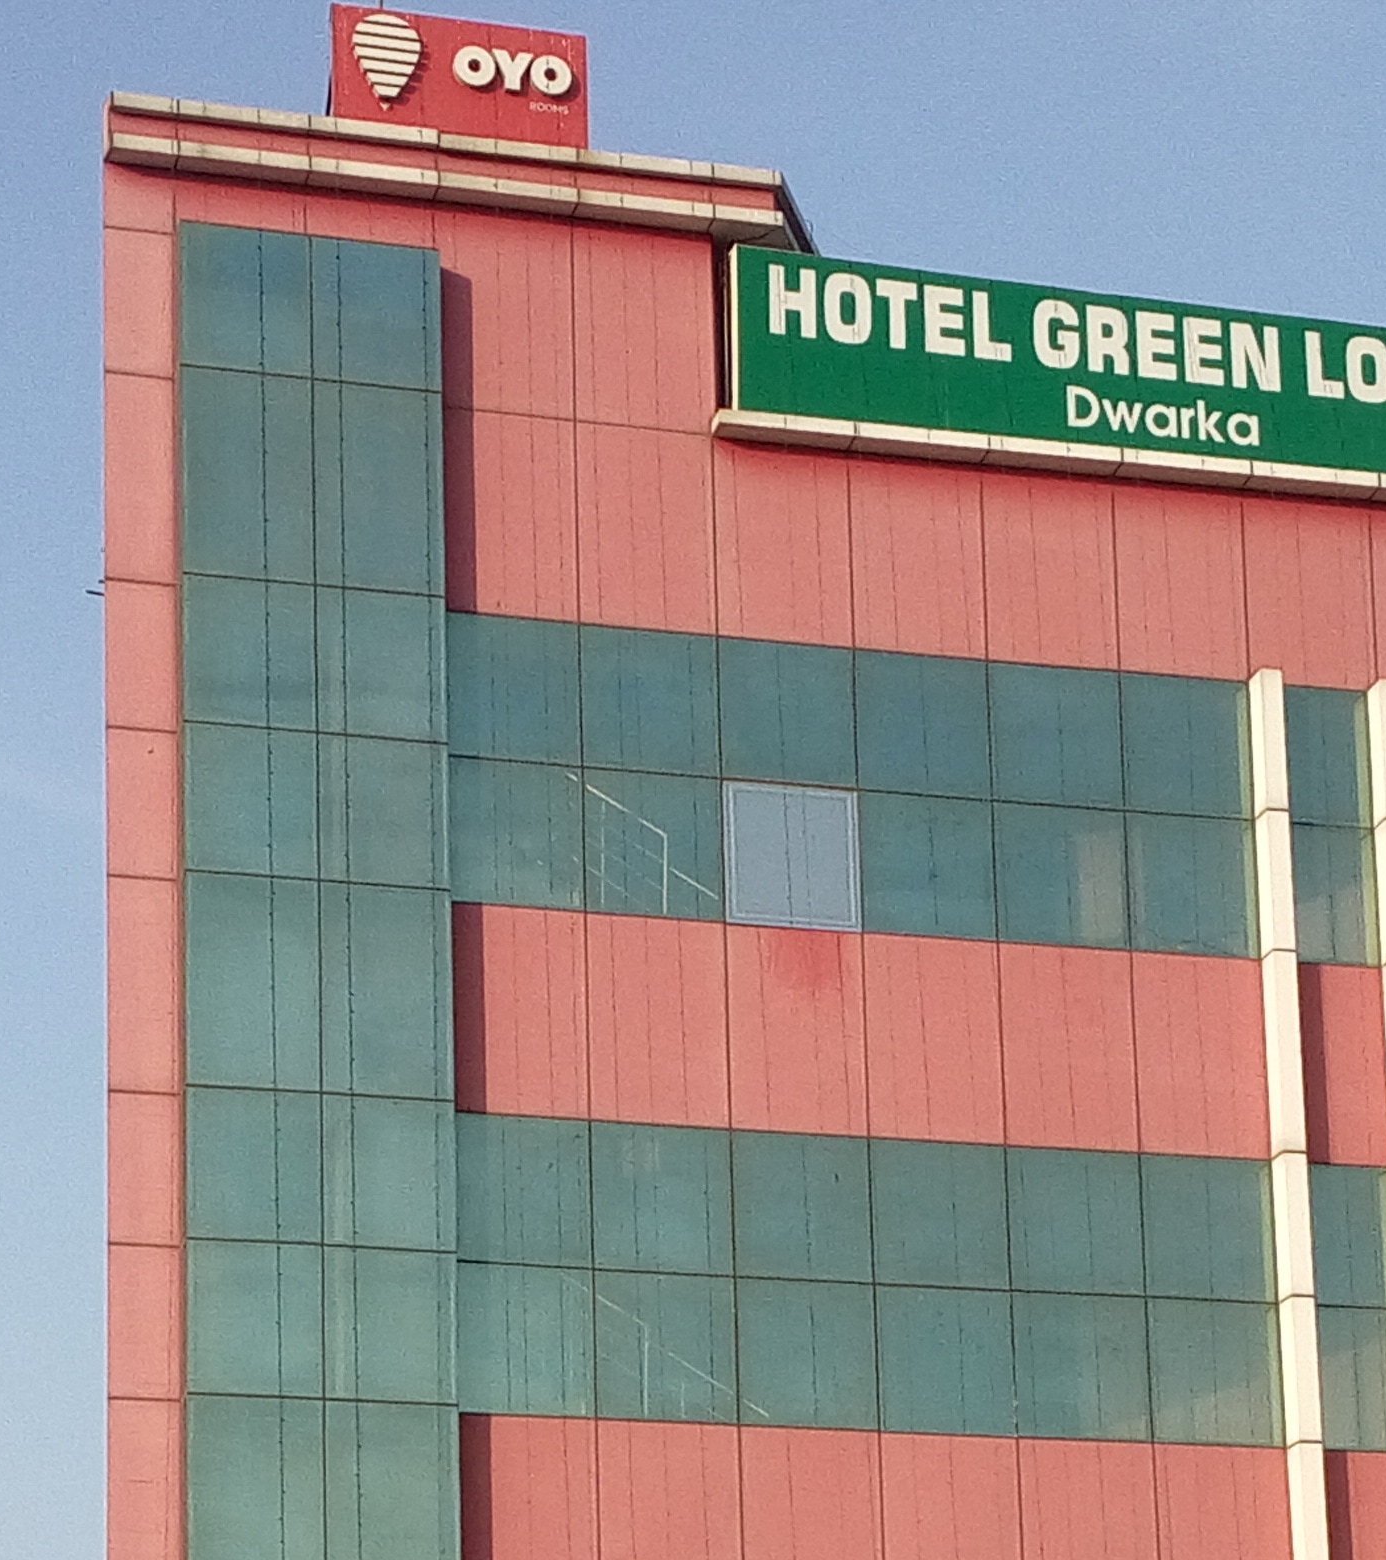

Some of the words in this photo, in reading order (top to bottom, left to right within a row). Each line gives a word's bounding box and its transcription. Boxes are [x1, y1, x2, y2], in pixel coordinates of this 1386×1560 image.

[453, 45, 573, 95] OYO
[528, 101, 570, 115] ROOMS
[767, 263, 1012, 362] HOTEL
[1032, 298, 1282, 393] GREEN
[1064, 384, 1262, 447] Dwarka
